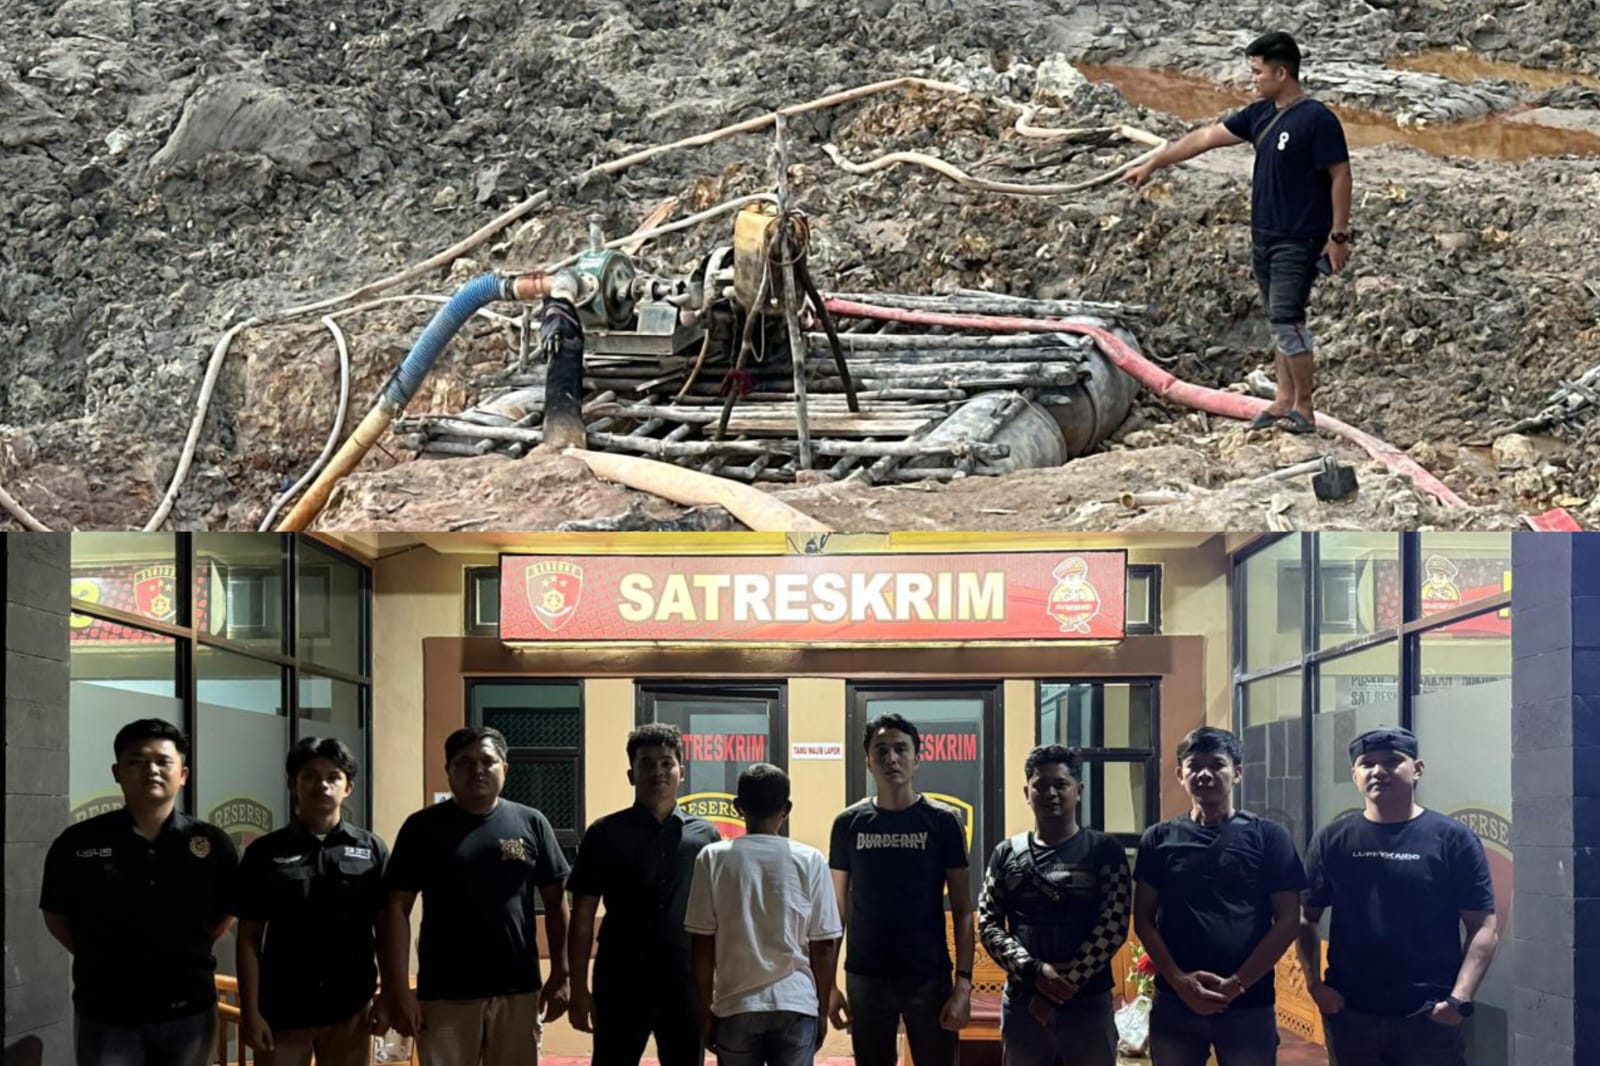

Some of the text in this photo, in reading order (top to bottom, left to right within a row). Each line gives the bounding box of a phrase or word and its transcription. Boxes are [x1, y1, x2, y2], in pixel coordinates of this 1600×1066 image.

[618, 572, 1006, 622] SATRESKRIM
[682, 733, 765, 761] TRESKRIM
[215, 804, 269, 829] RESERSE
[679, 801, 741, 818] ESERS
